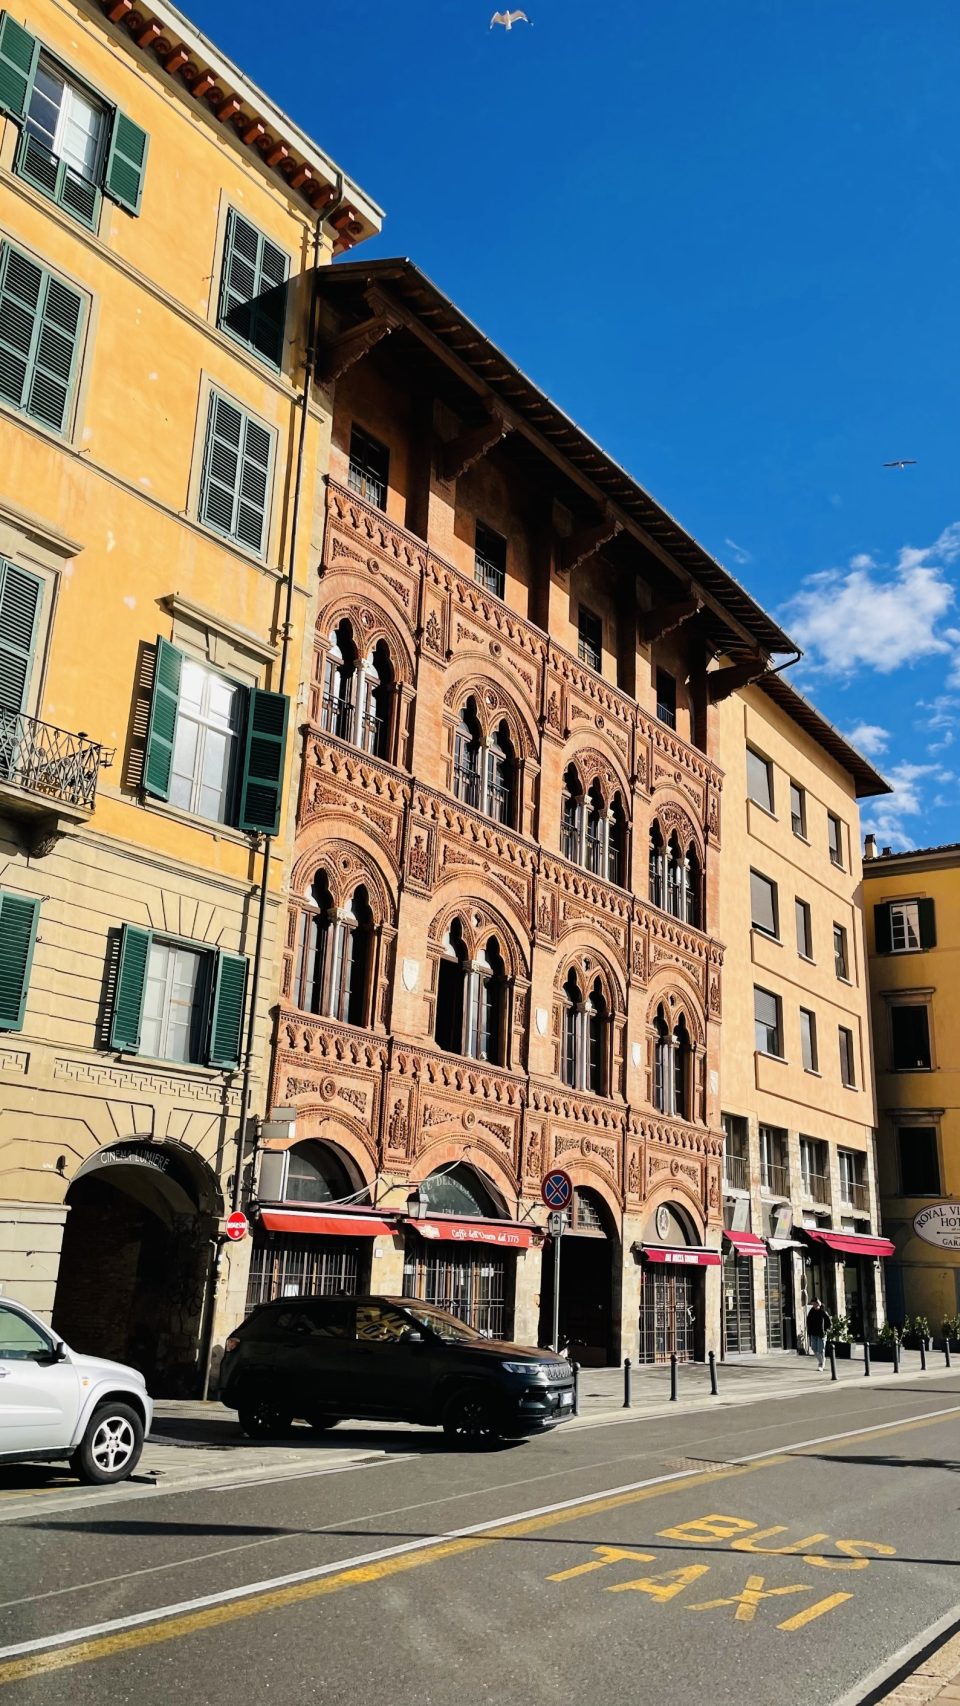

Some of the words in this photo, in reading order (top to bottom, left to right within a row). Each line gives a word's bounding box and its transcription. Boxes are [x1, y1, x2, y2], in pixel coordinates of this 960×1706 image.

[100, 1149, 132, 1164] CINEMA
[916, 1208, 946, 1228] ROYAL
[942, 1238, 960, 1247] GAR
[655, 1513, 897, 1571] BUS
[545, 1545, 855, 1632] TAXI
